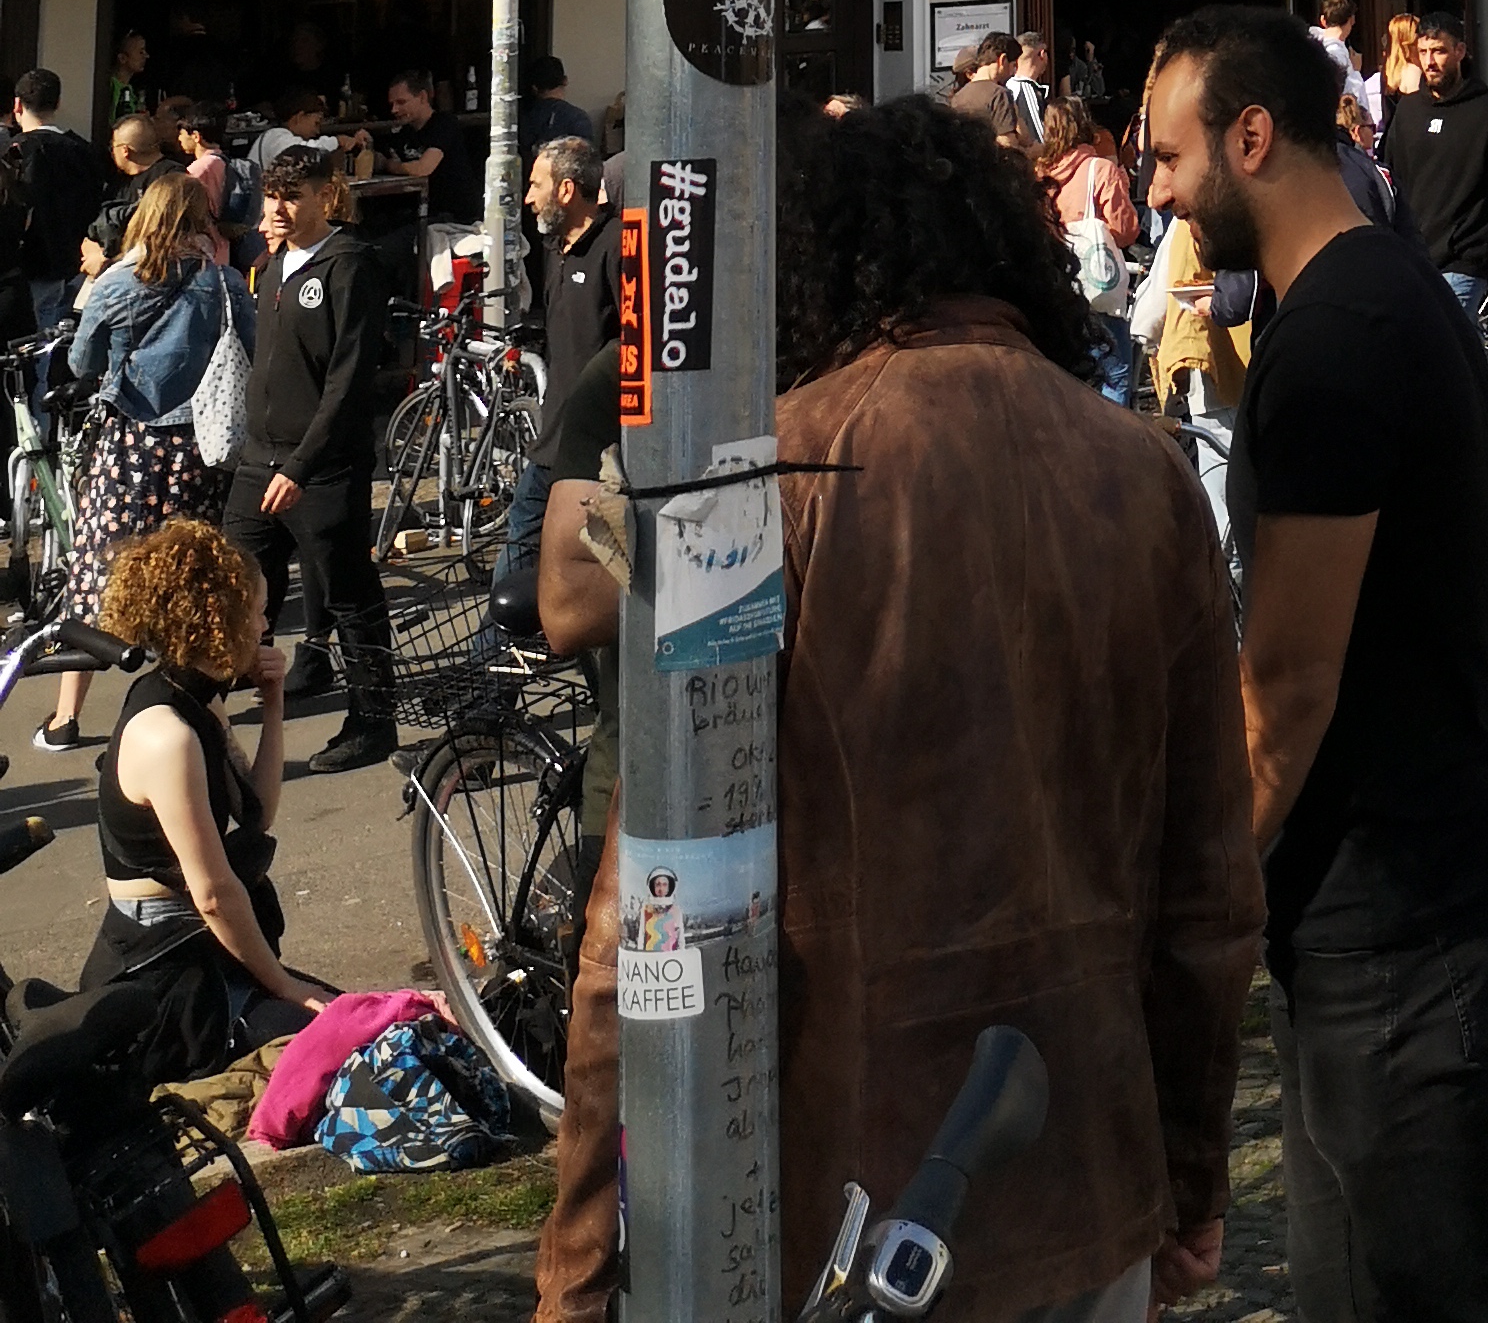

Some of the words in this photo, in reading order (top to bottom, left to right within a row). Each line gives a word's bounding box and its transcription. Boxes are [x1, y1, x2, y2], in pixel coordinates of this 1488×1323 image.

[955, 22, 990, 31] Zahnarzt
[620, 958, 684, 985] NANO
[622, 984, 697, 1014] KAFFEE
